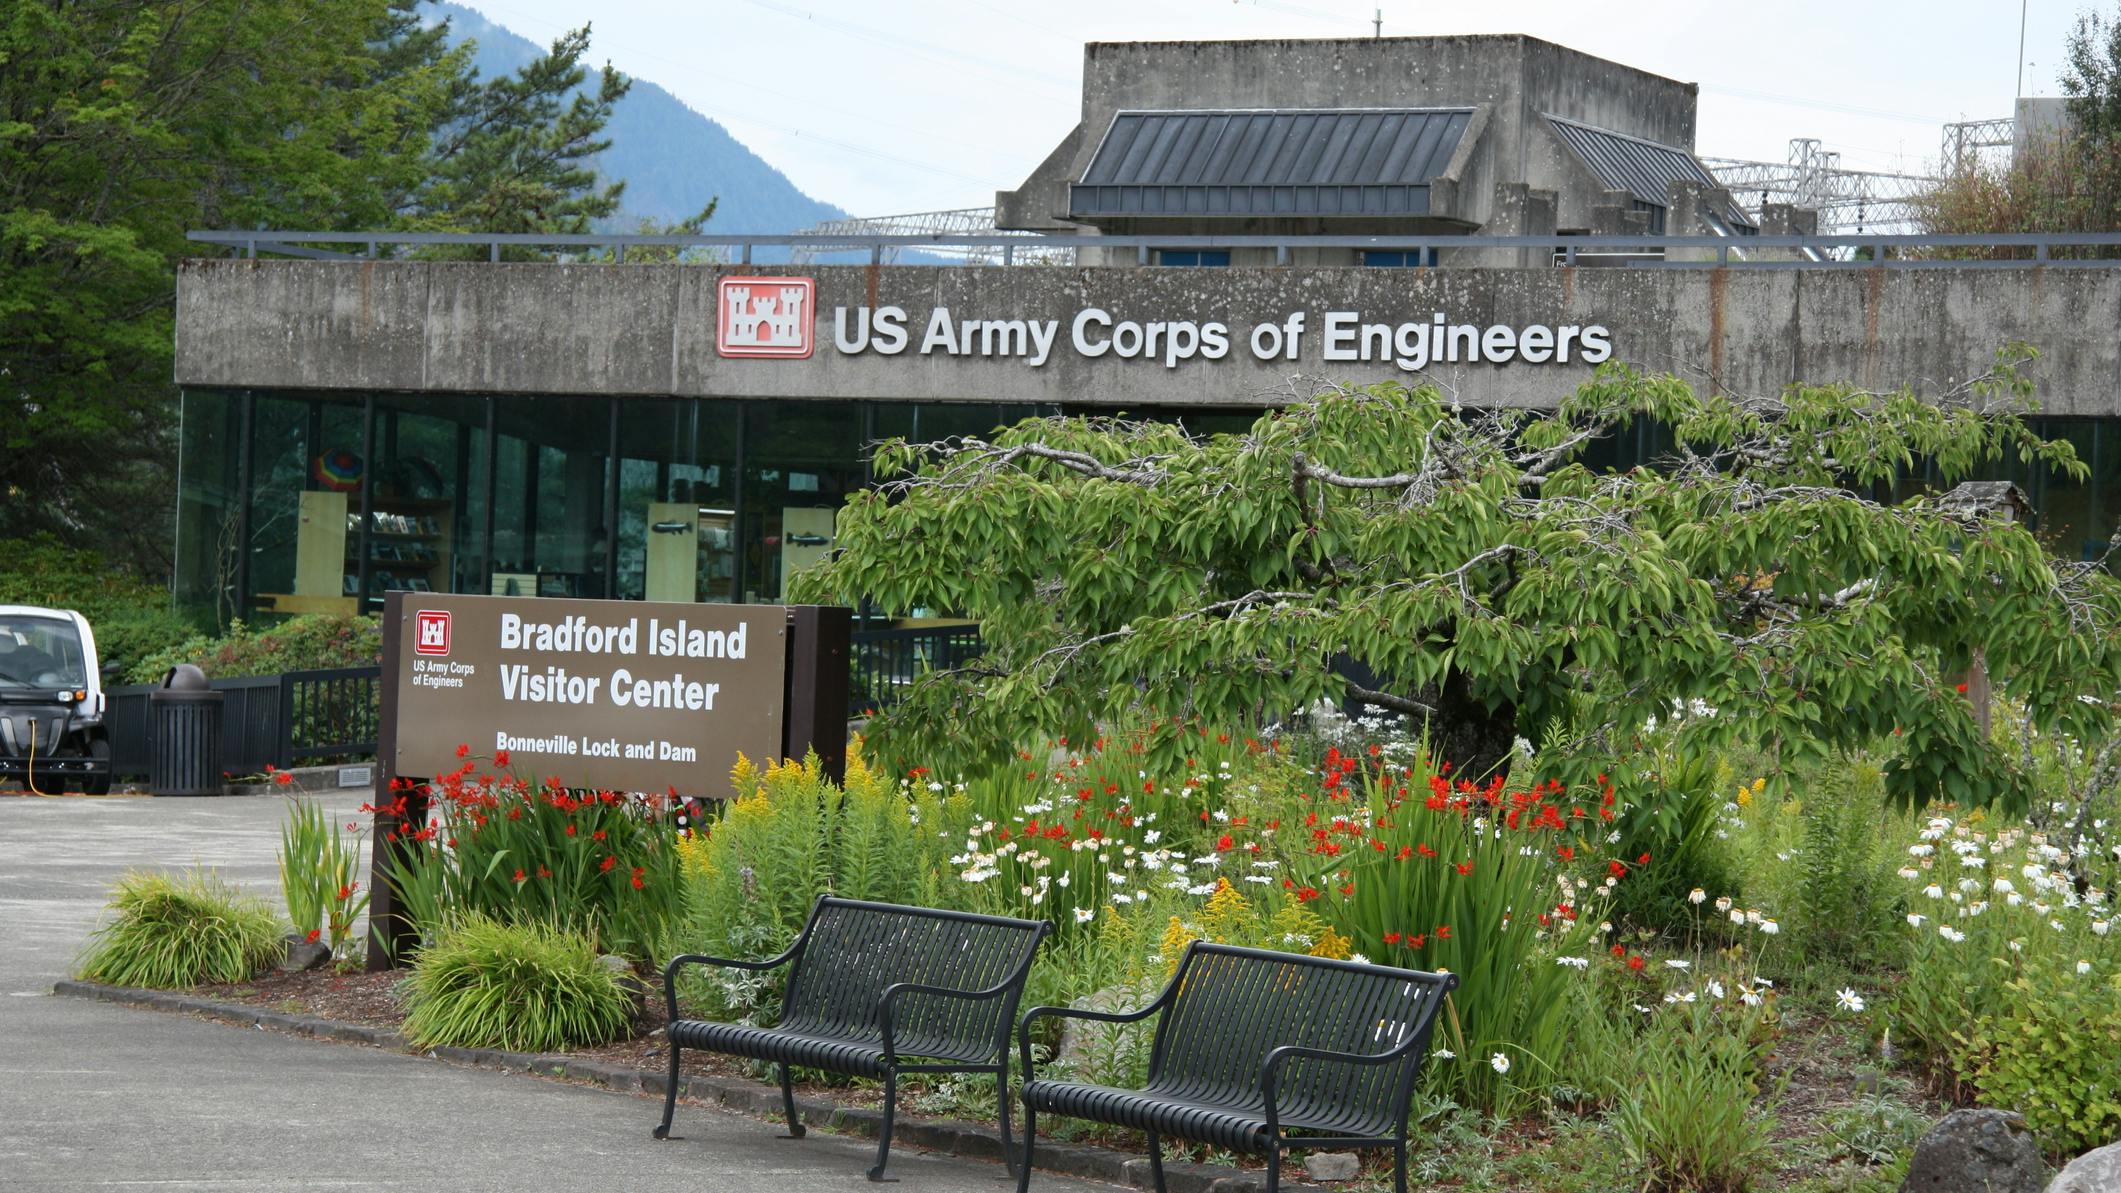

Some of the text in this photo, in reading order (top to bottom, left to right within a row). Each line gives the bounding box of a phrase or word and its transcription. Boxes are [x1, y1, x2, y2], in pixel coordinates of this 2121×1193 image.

[834, 306, 1612, 371] US Army Corps of Engineers
[500, 613, 747, 660] Bradford Island
[412, 673, 464, 690] of Engineers
[413, 659, 475, 677] US Army Corps
[499, 664, 720, 711] Visitor Center
[496, 731, 697, 762] Bonneville Lock and Dam
